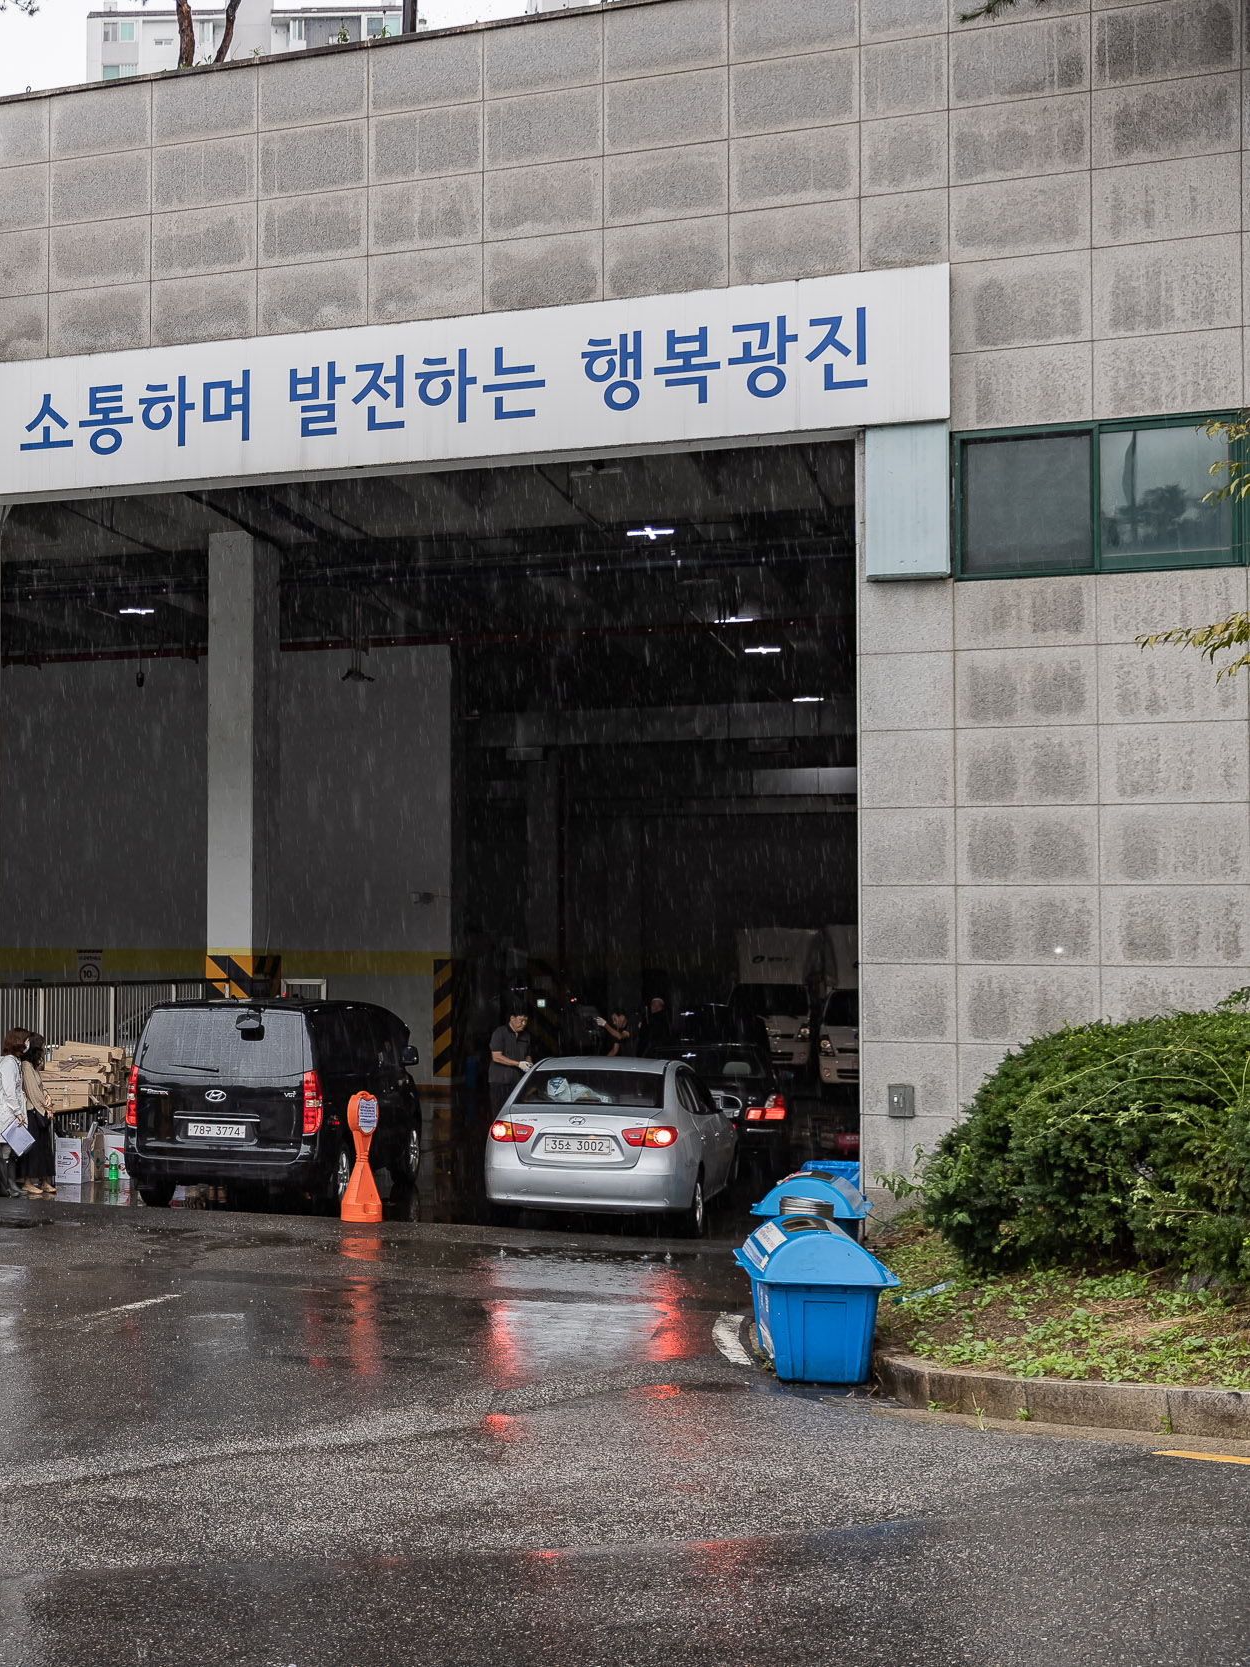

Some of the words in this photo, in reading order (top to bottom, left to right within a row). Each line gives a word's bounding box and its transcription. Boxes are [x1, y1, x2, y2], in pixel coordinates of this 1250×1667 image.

[19, 369, 251, 456] 소통하며
[288, 346, 546, 438] 발전하는
[580, 306, 869, 412] 행복광진
[193, 1125, 212, 1135] 78구
[215, 1125, 241, 1136] 3774
[551, 1139, 571, 1150] 35소
[576, 1140, 604, 1152] 3002
